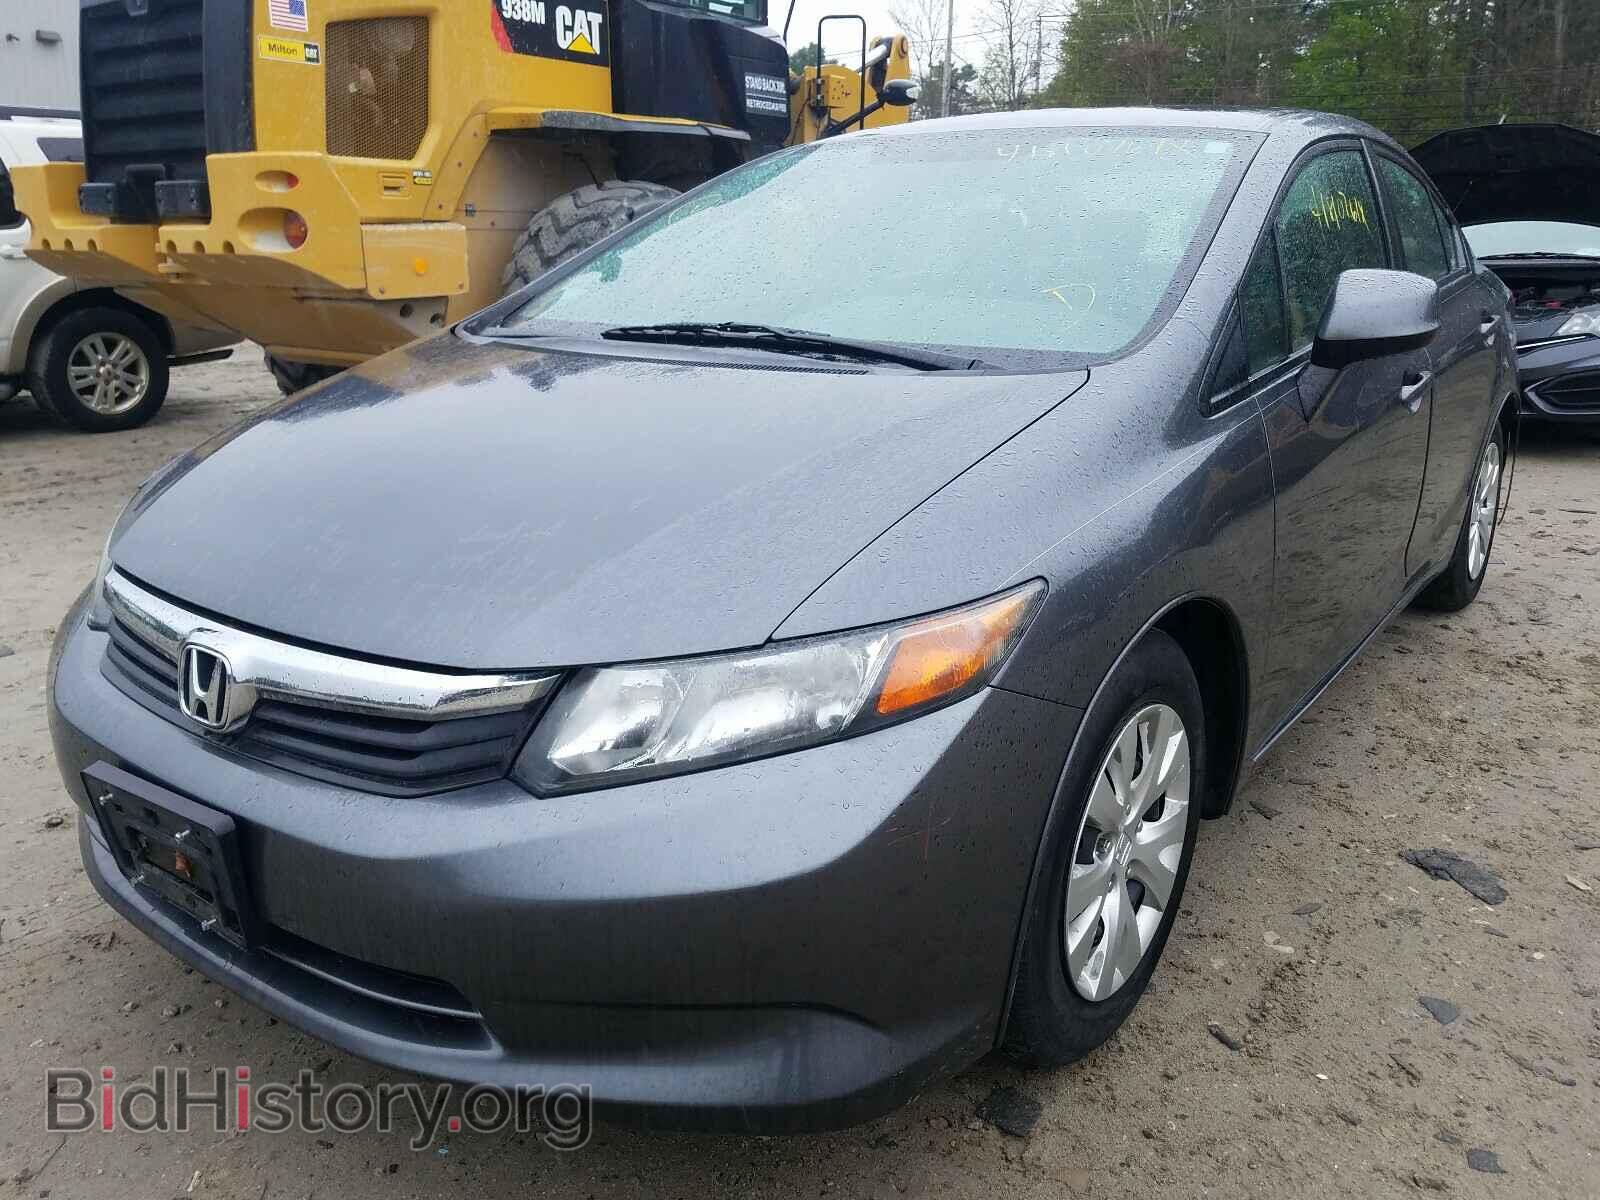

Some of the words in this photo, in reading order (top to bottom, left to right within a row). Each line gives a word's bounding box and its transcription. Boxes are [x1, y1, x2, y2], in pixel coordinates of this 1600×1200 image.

[501, 0, 546, 25] 938M
[555, 5, 602, 55] CAT
[267, 43, 298, 57] Milton
